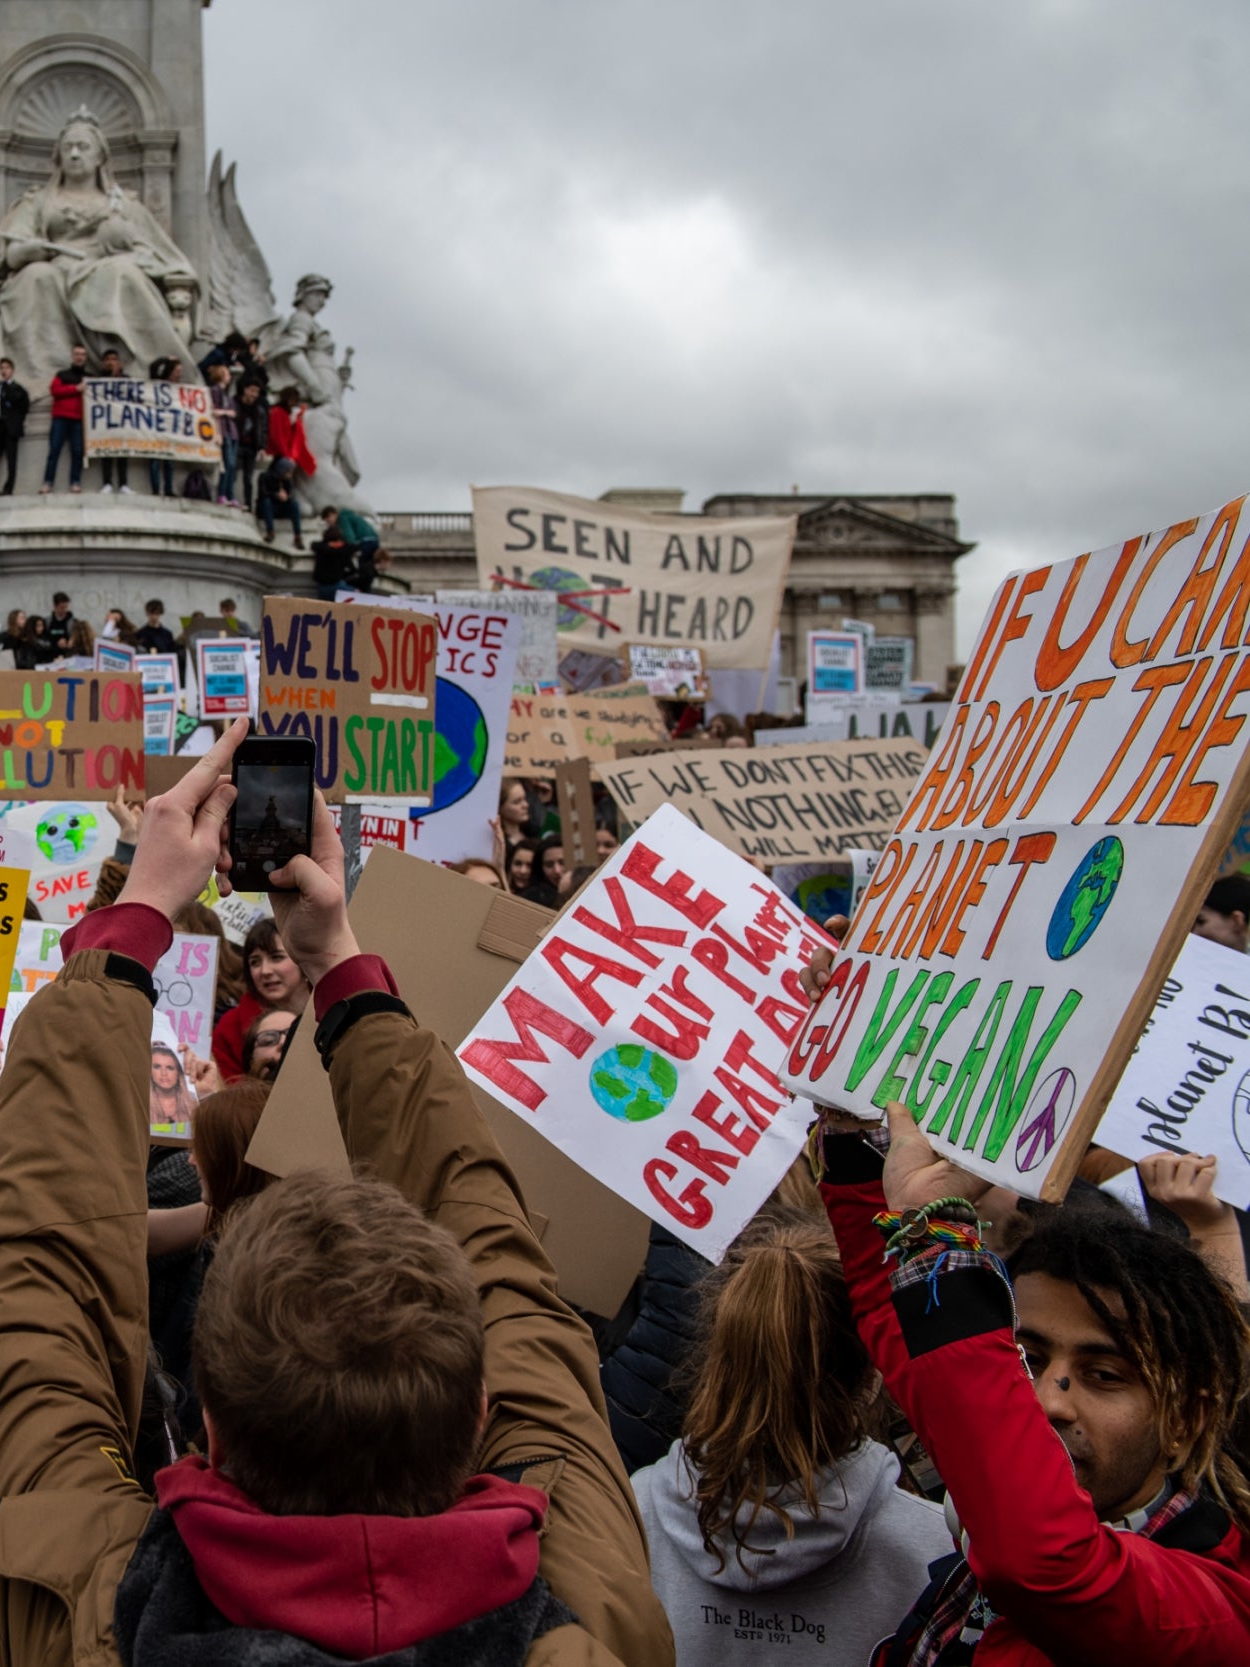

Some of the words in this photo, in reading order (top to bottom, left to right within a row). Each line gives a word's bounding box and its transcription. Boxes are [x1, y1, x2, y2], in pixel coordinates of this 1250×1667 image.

[86, 381, 146, 404] THERE
[153, 383, 173, 406] IS
[178, 386, 207, 413] NO
[91, 405, 181, 433] PLANET
[504, 507, 632, 565] SEEN
[661, 533, 755, 575] AND
[435, 612, 508, 650] NGE
[638, 588, 755, 641] HEARD
[959, 565, 1053, 705] IF
[1034, 534, 1144, 693] U
[264, 611, 360, 683] WE'LL
[370, 616, 436, 694] STOP
[444, 647, 499, 679] ICS
[265, 686, 337, 710] WHEN
[540, 706, 567, 719] are
[343, 715, 434, 794] START
[506, 730, 531, 744] or
[551, 731, 567, 747] a
[895, 676, 1116, 835] ABOUT
[1071, 651, 1250, 827] THE
[608, 770, 643, 805] IF
[649, 761, 718, 798] WE
[806, 753, 859, 783] FIX
[853, 750, 926, 781] THIS
[382, 819, 399, 836] IN
[710, 788, 878, 832] NOTHING
[740, 834, 810, 858] WILL
[811, 829, 893, 857] MATTE
[35, 870, 92, 902] SAVE
[842, 831, 1058, 962] PLANET
[175, 941, 211, 977] IS
[460, 841, 727, 1113] MAKE
[787, 957, 871, 1082] GO
[844, 968, 1083, 1163] VEGAN
[1136, 1039, 1235, 1159] planet
[643, 1027, 791, 1231] GREAT
[701, 1605, 732, 1626] The
[738, 1609, 784, 1632] Black
[791, 1614, 826, 1644] Dog
[768, 1632, 791, 1645] 1971
